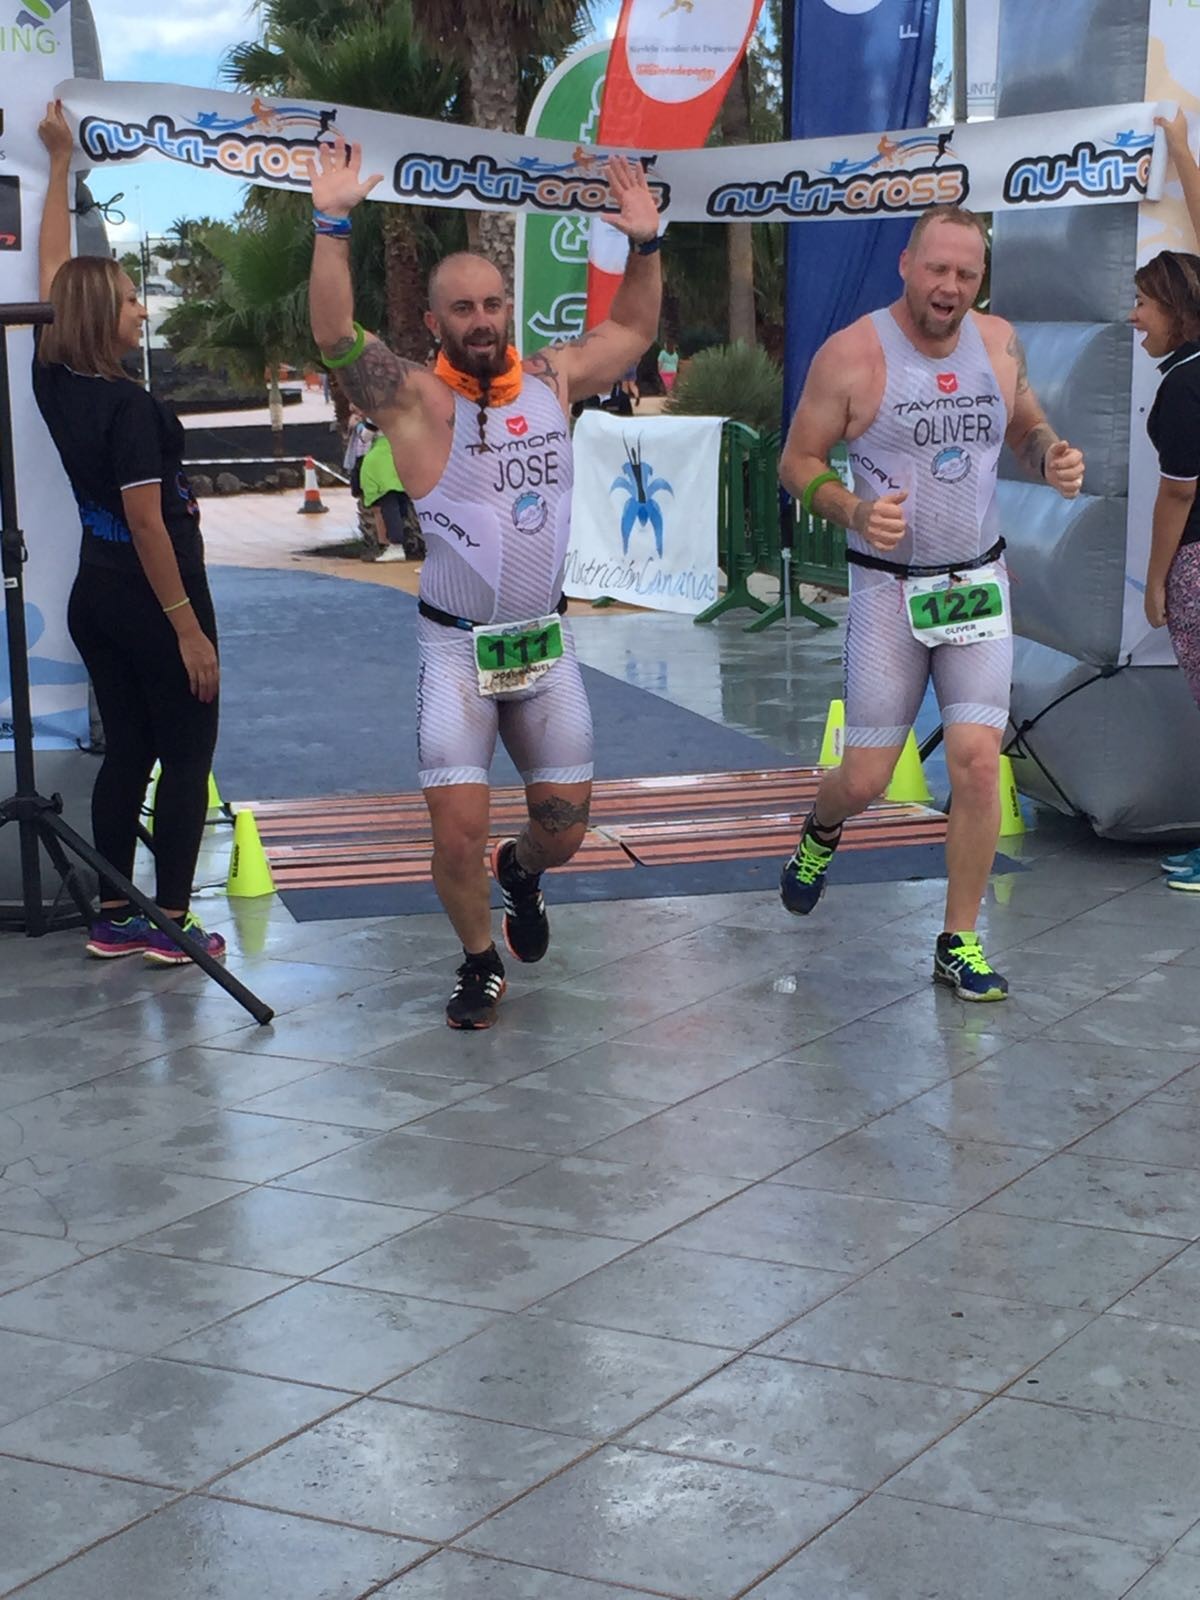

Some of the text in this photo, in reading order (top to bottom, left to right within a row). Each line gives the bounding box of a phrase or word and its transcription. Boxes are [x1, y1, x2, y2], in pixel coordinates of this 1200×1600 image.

[82, 117, 351, 185] nu-tri-cros
[708, 164, 969, 216] nu-tri-cross
[465, 431, 567, 456] TAYMORY
[914, 414, 992, 446] OLIVER
[493, 451, 558, 492] JOSE
[922, 588, 992, 624] 122
[945, 624, 977, 635] OLIVER
[488, 631, 548, 667] 111
